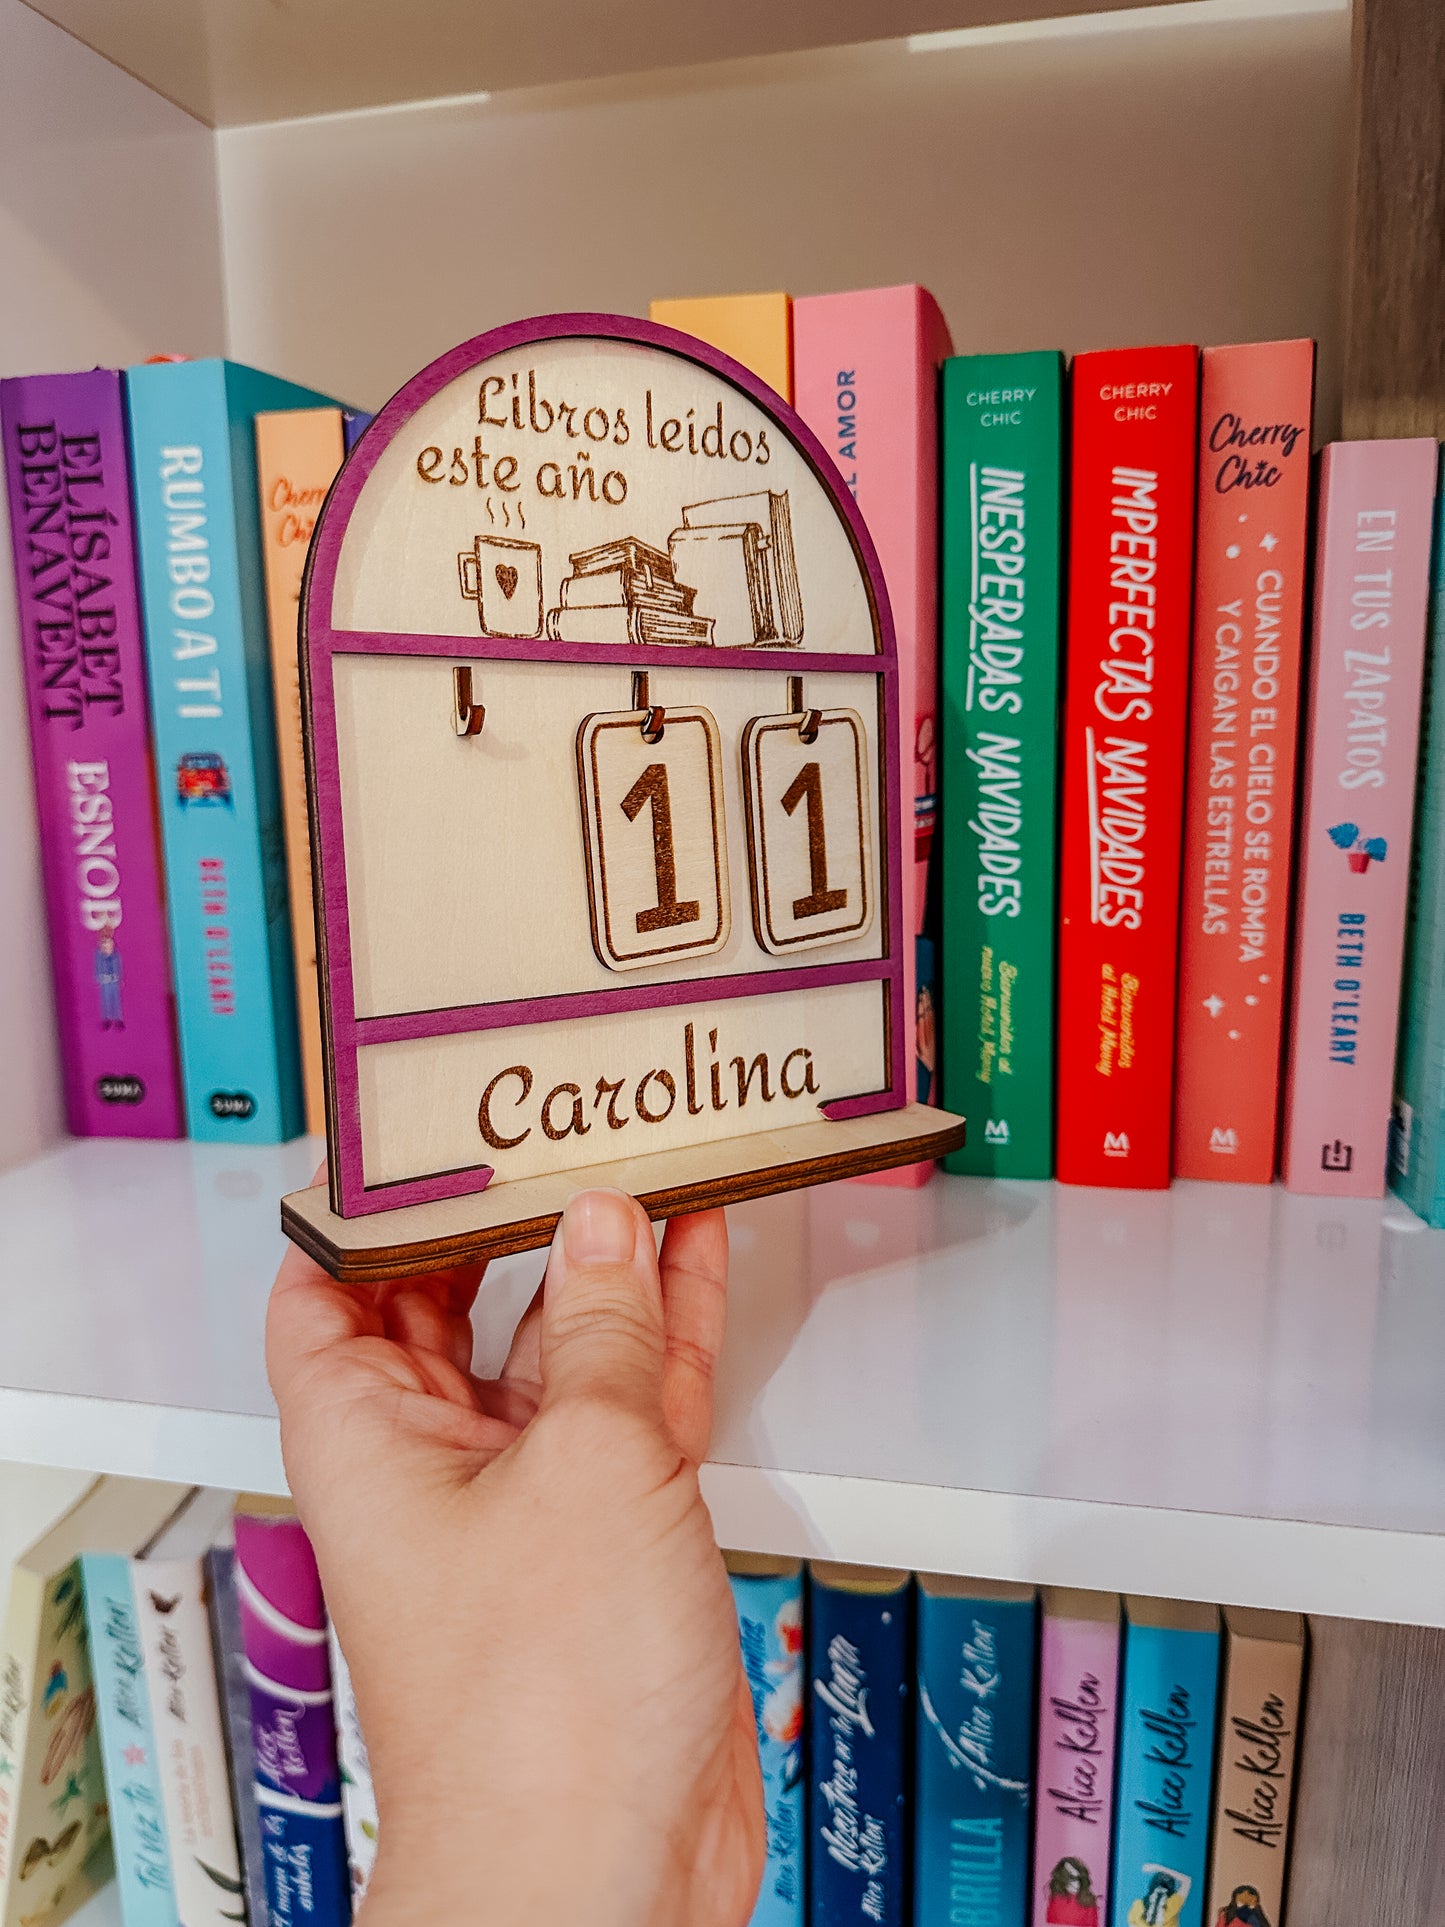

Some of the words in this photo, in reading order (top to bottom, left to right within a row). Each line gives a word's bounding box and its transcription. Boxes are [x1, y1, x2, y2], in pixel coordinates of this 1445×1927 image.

[478, 370, 630, 446] Libros
[645, 390, 771, 465] leídos
[837, 370, 857, 460] AMOR
[966, 388, 1036, 407] CHERRY
[980, 411, 1022, 427] CHIC
[1100, 383, 1173, 401] CHERRY
[1114, 405, 1157, 422] CHIC
[417, 436, 520, 492] este
[536, 451, 628, 505] año
[1209, 413, 1305, 457] Cherry
[1215, 455, 1283, 494] Chic
[160, 446, 215, 620] RUMBO
[1356, 510, 1396, 552] EN
[17, 420, 84, 731] BENAVENT
[61, 431, 124, 717] ELÍSABET
[969, 466, 1025, 714] INESPERADAS
[1094, 466, 1158, 721] IMPERFECTAS
[1217, 600, 1242, 617] Y
[1350, 568, 1393, 630] TUS
[173, 629, 218, 660] A
[1252, 569, 1283, 700] CUANDO
[175, 668, 223, 718] TI
[1212, 623, 1242, 733] CAIGAN
[1338, 647, 1392, 791] ZAPATOS
[1250, 707, 1277, 738] EL
[1208, 742, 1238, 789] LAS
[1245, 742, 1275, 825] CIELO
[67, 759, 123, 931] ESNOB
[619, 763, 700, 933] 1
[780, 762, 848, 920] 1
[966, 732, 1022, 918] NAVIDADES
[1096, 736, 1148, 930] NAVIDADES
[1202, 796, 1234, 935] ESTRELLAS
[1243, 830, 1270, 861] SE
[1238, 868, 1270, 963] ROMPA
[1336, 912, 1366, 969] BETH
[1101, 984, 1119, 1026] Hotel
[1328, 979, 1361, 1066] O'LEARY
[478, 1022, 820, 1149] Carolina
[1050, 1672, 1106, 1755] Kellen
[1139, 1684, 1197, 1768] Kellen
[1232, 1692, 1291, 1778] Kellen
[1047, 1759, 1103, 1825] Alice
[1135, 1775, 1193, 1838] Alice
[1225, 1780, 1284, 1848] Alice
[951, 1817, 1003, 1926] BRILLA
